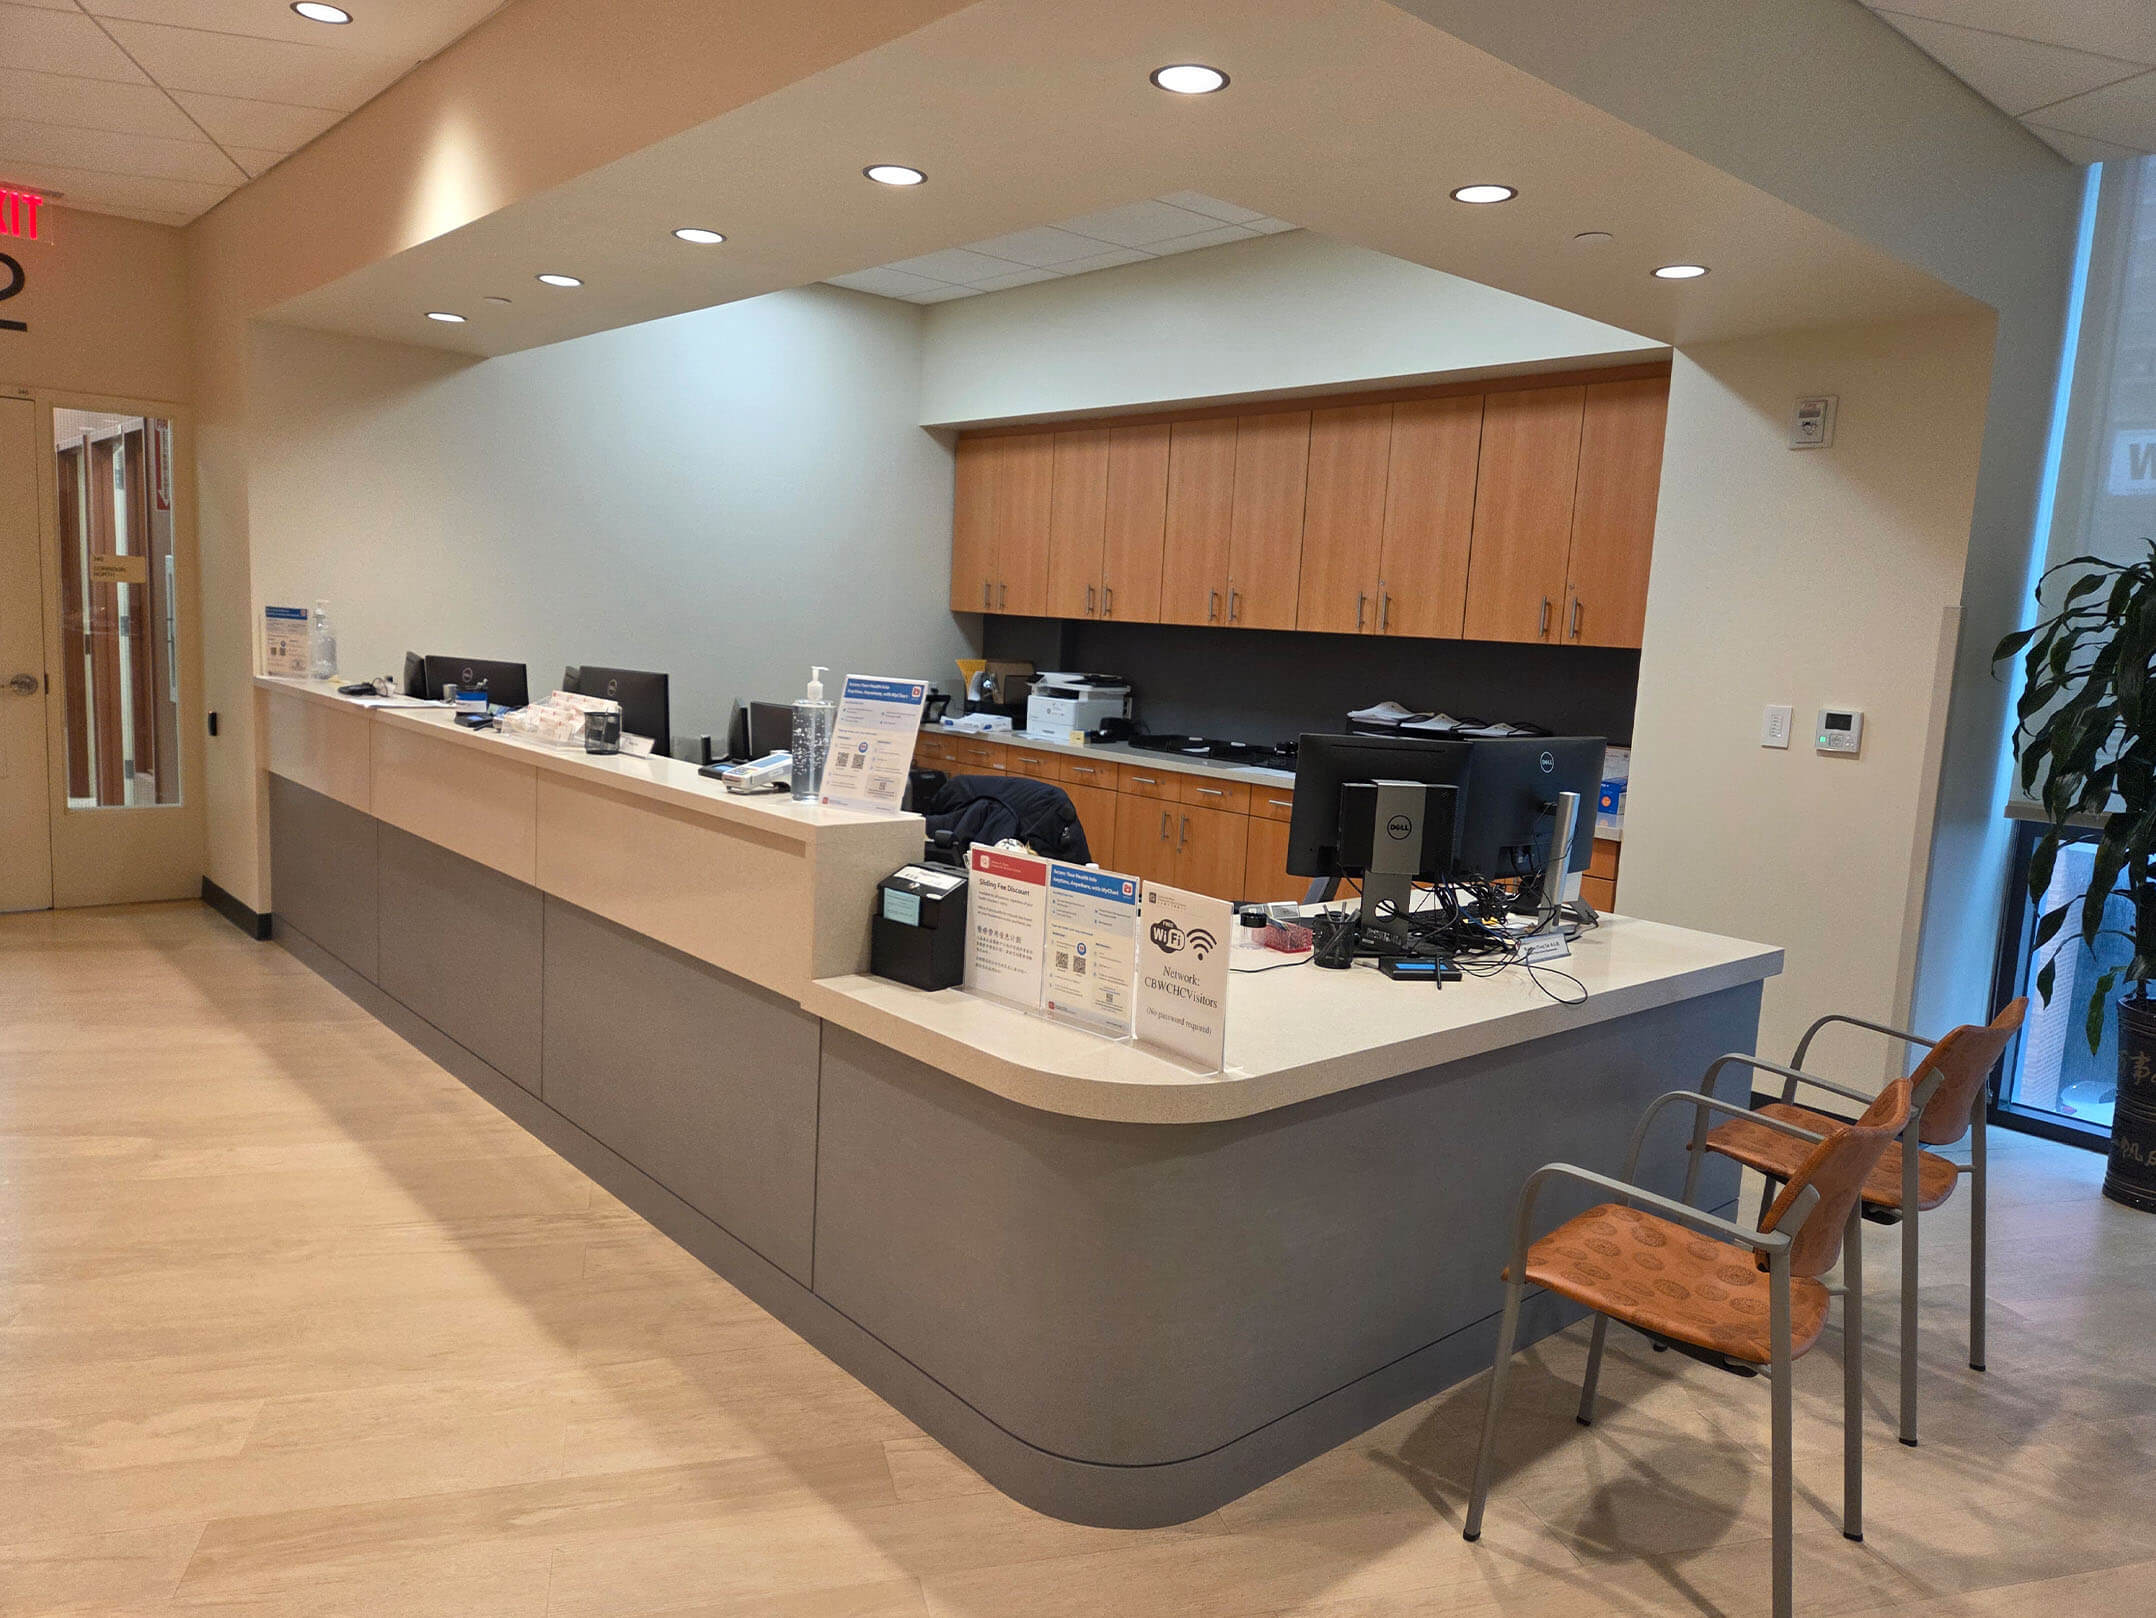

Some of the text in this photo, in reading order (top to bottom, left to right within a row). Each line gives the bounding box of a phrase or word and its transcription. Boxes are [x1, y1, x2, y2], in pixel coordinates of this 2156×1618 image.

[979, 878, 1030, 896] Sliding Fee Discount
[1163, 965, 1201, 987] Network:
[1144, 976, 1218, 1009] CBWCHCVisitors
[1158, 1011, 1185, 1026] password
